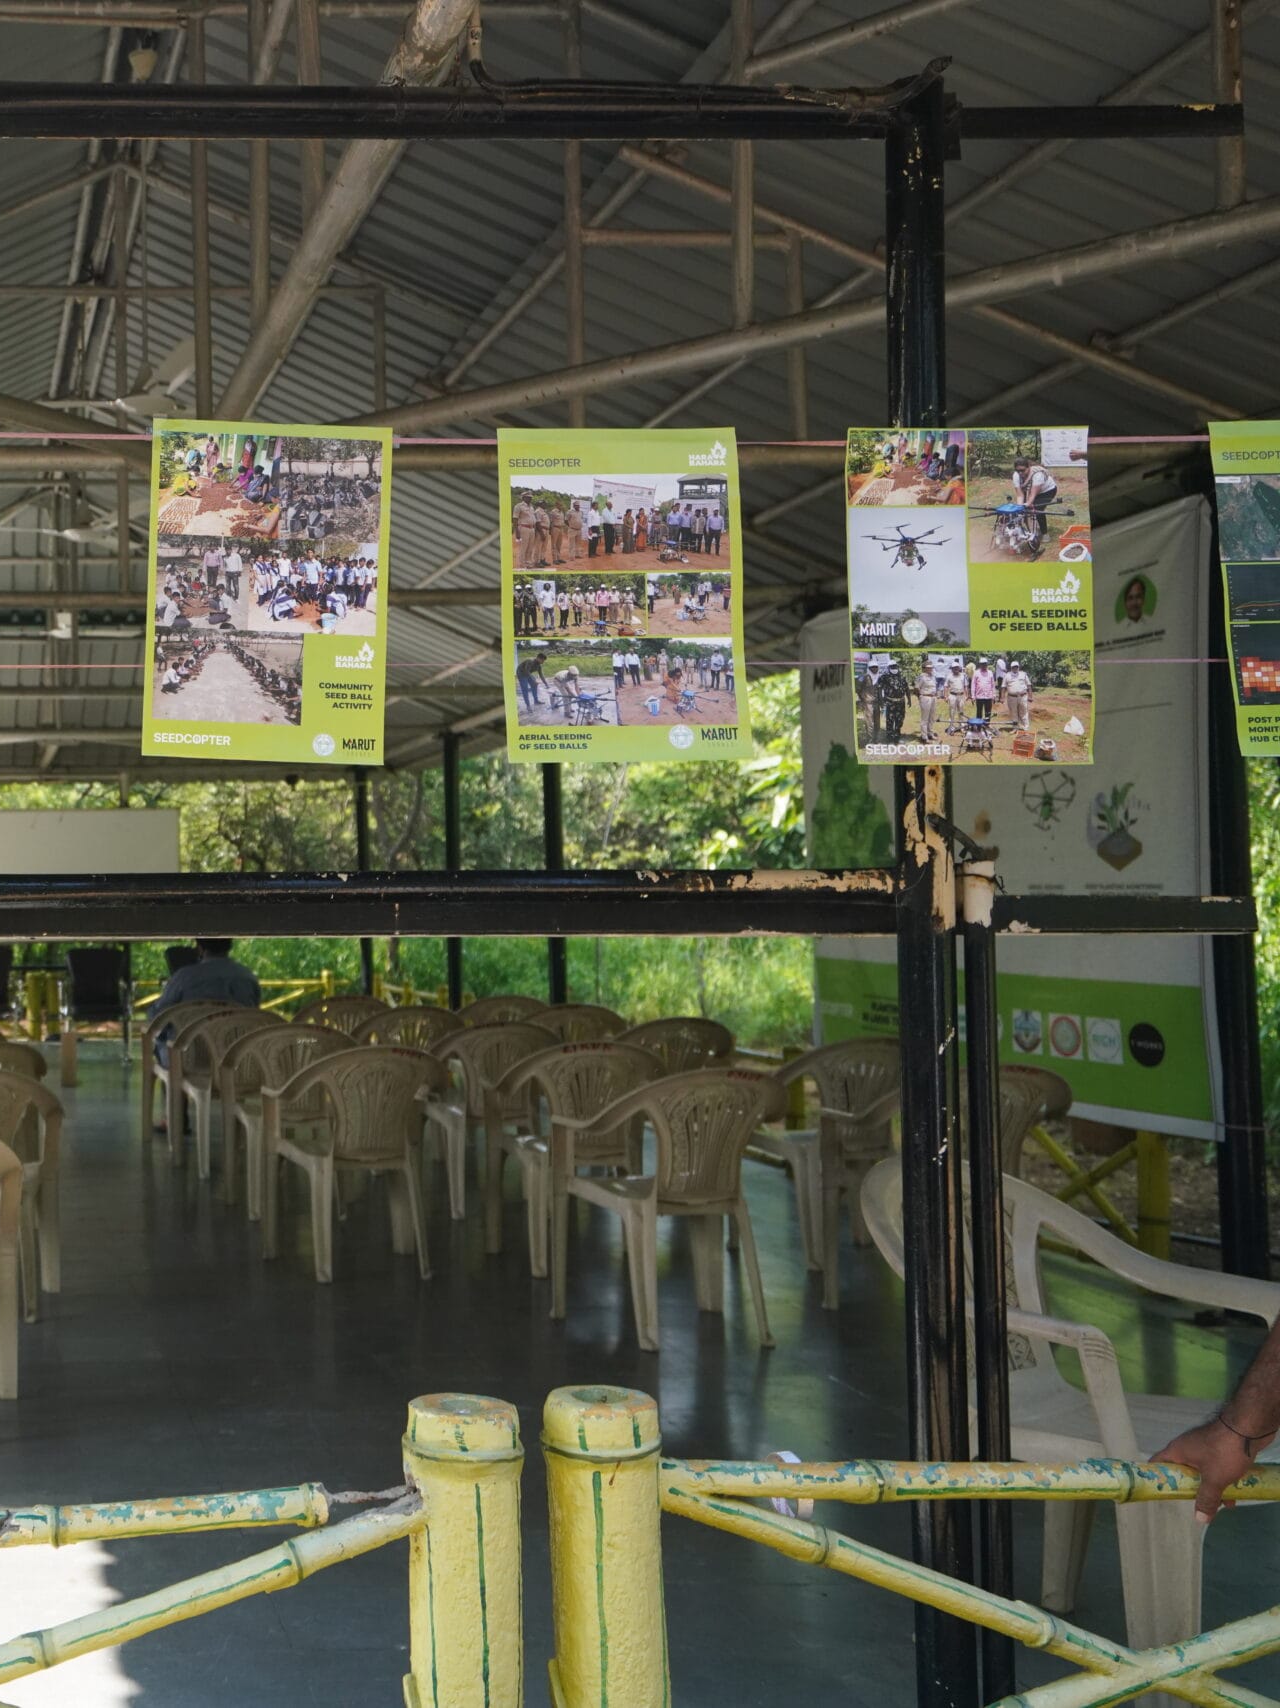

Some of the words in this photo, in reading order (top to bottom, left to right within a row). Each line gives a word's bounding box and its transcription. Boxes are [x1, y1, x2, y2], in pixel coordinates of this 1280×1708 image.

[508, 458, 581, 468] SEEDCOPTER
[689, 459, 726, 467] BAHARA
[1032, 588, 1062, 596] HARA
[1032, 594, 1078, 603] BAHARA
[981, 609, 1028, 619] AERIAL
[1031, 609, 1087, 619] SEEDING
[859, 622, 897, 636] MARUT
[989, 622, 1007, 632] OF
[1010, 622, 1044, 632] SEED
[1046, 621, 1088, 632] BALLS
[335, 655, 359, 663] HARA
[335, 661, 372, 669] BAHARA
[319, 682, 373, 691] COMMUNITY
[325, 692, 348, 700] SEED
[350, 693, 373, 701] BALL
[332, 702, 373, 710] ACTIVITY
[553, 733, 592, 741] SEEDING
[701, 727, 739, 741] MARUT
[153, 732, 231, 746] SEEDCOPTER
[342, 738, 376, 751] MARUT
[559, 742, 588, 750] BALLS
[865, 743, 951, 756] SEEDCOPTER
